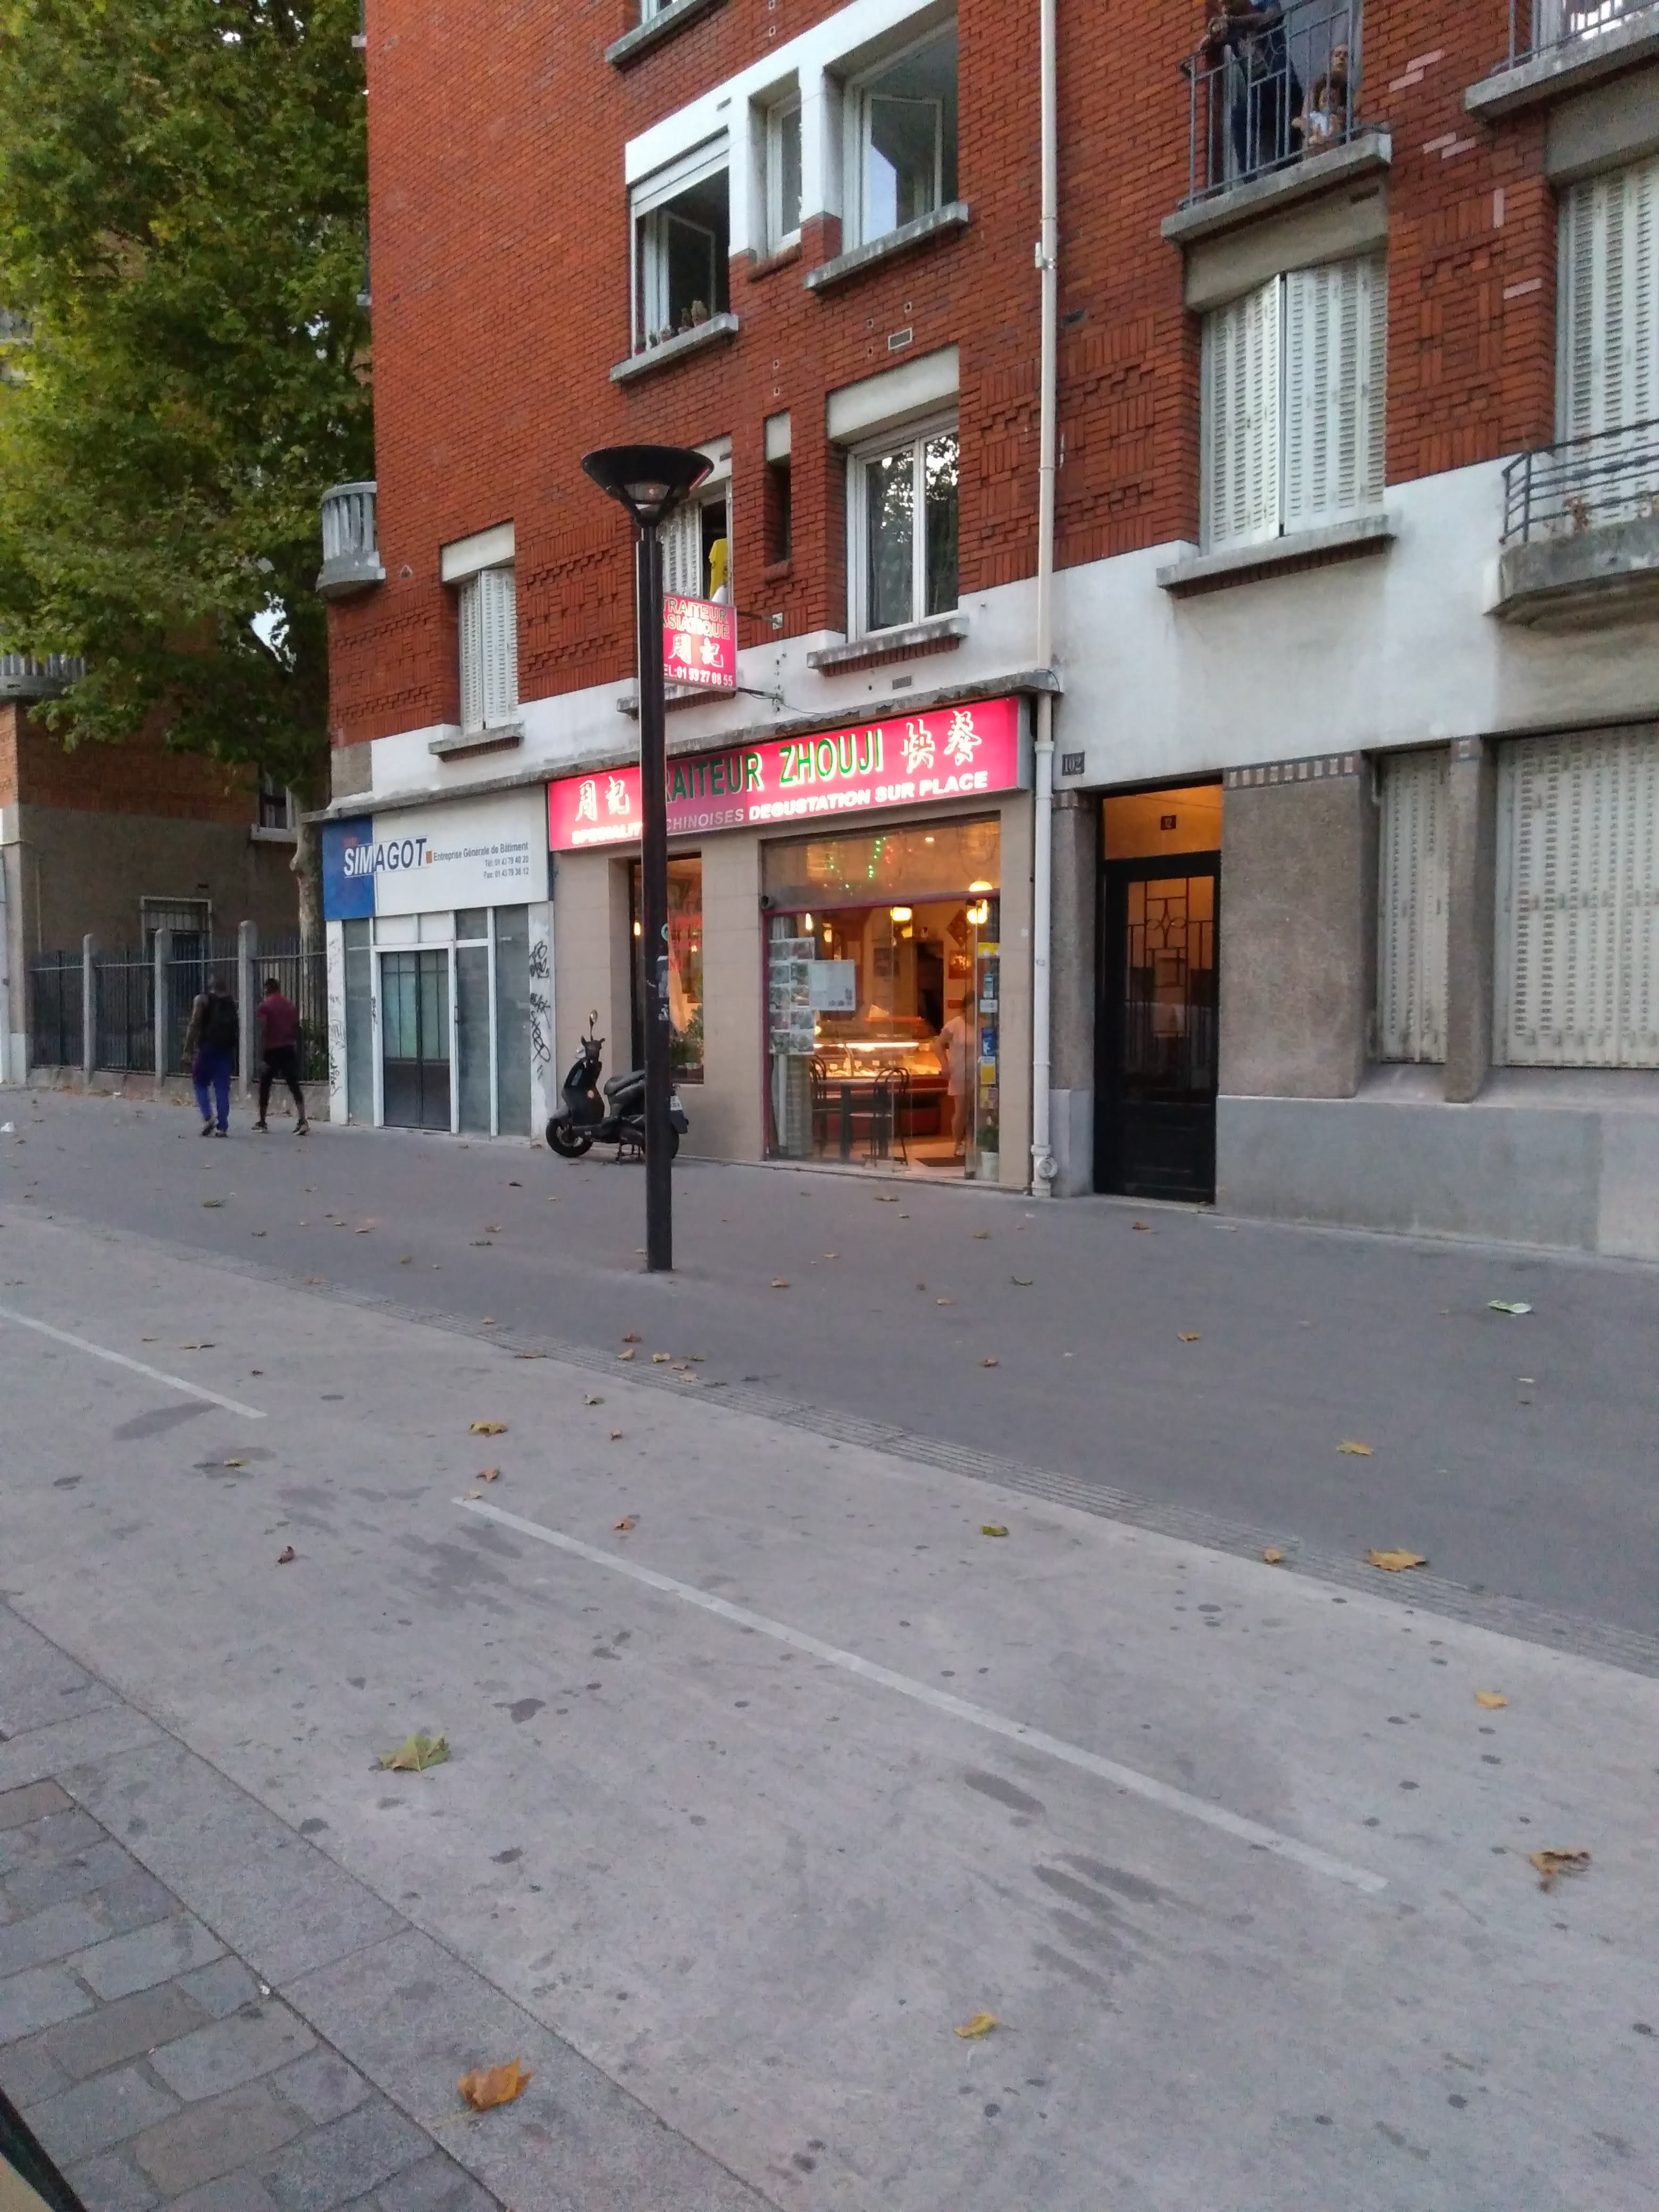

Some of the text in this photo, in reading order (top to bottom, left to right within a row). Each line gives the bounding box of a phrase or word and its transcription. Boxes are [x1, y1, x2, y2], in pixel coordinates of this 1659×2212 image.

[700, 669, 710, 683] 27
[723, 674, 733, 686] 55
[779, 728, 884, 787] ZHOUJI
[1065, 756, 1082, 772] 102
[749, 789, 871, 820] DEGUSTATION
[875, 782, 916, 802] SUR
[919, 770, 988, 797] PLACE
[343, 838, 428, 876] SIMAGOT
[433, 842, 529, 862] Entreprise Générale de Bâtiment
